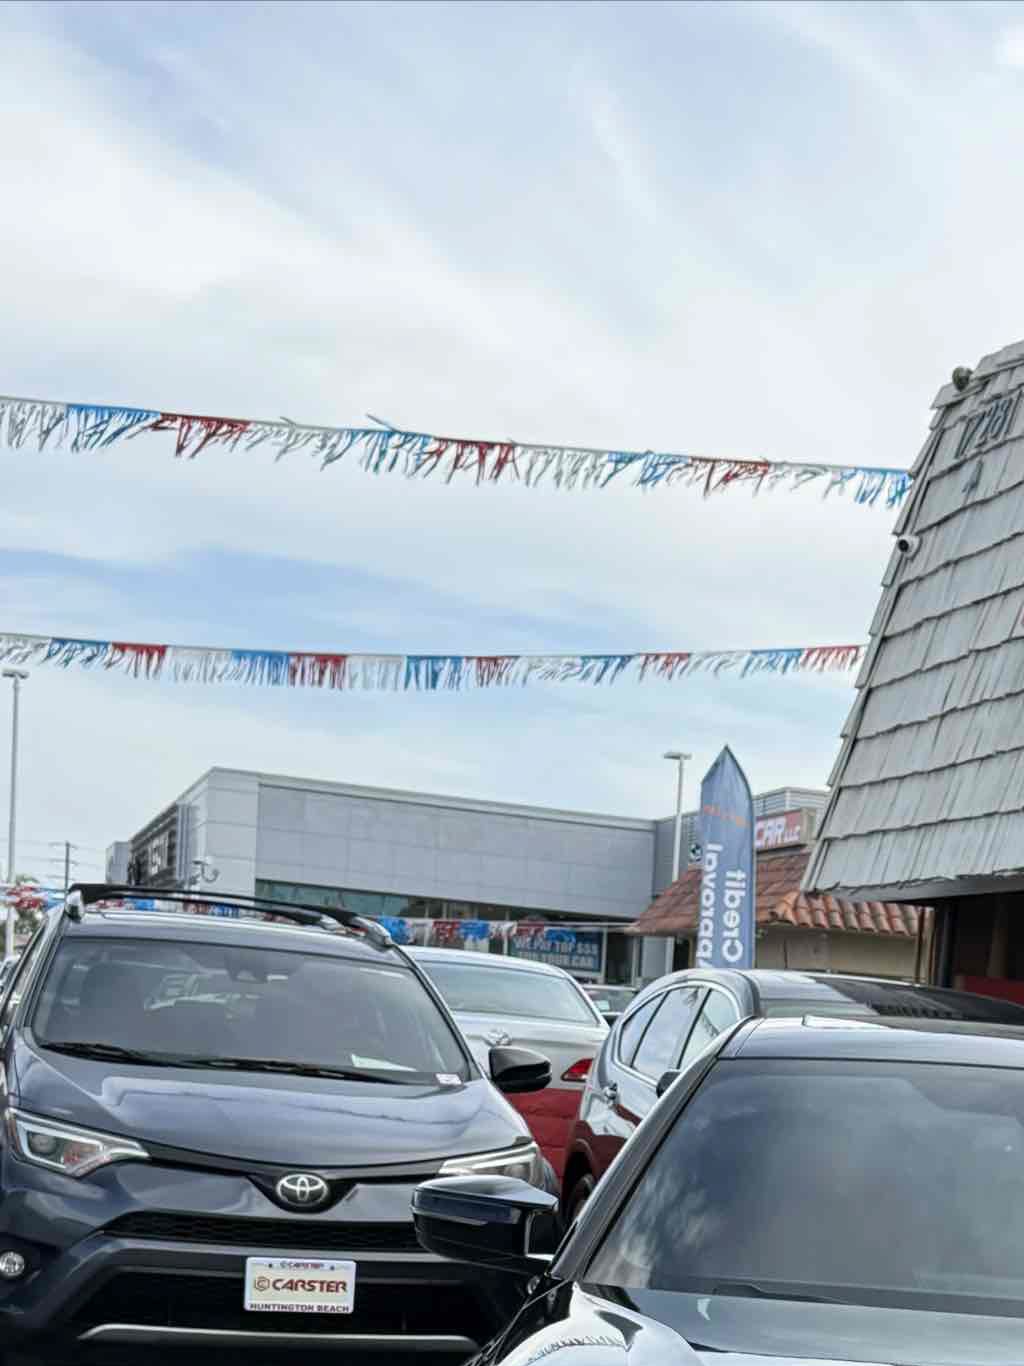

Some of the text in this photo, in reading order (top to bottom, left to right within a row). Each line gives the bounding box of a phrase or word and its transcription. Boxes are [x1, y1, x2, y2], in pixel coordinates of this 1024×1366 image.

[272, 1278, 347, 1293] CARSTER
[250, 1303, 349, 1313] HUNTINGTON BEACH
